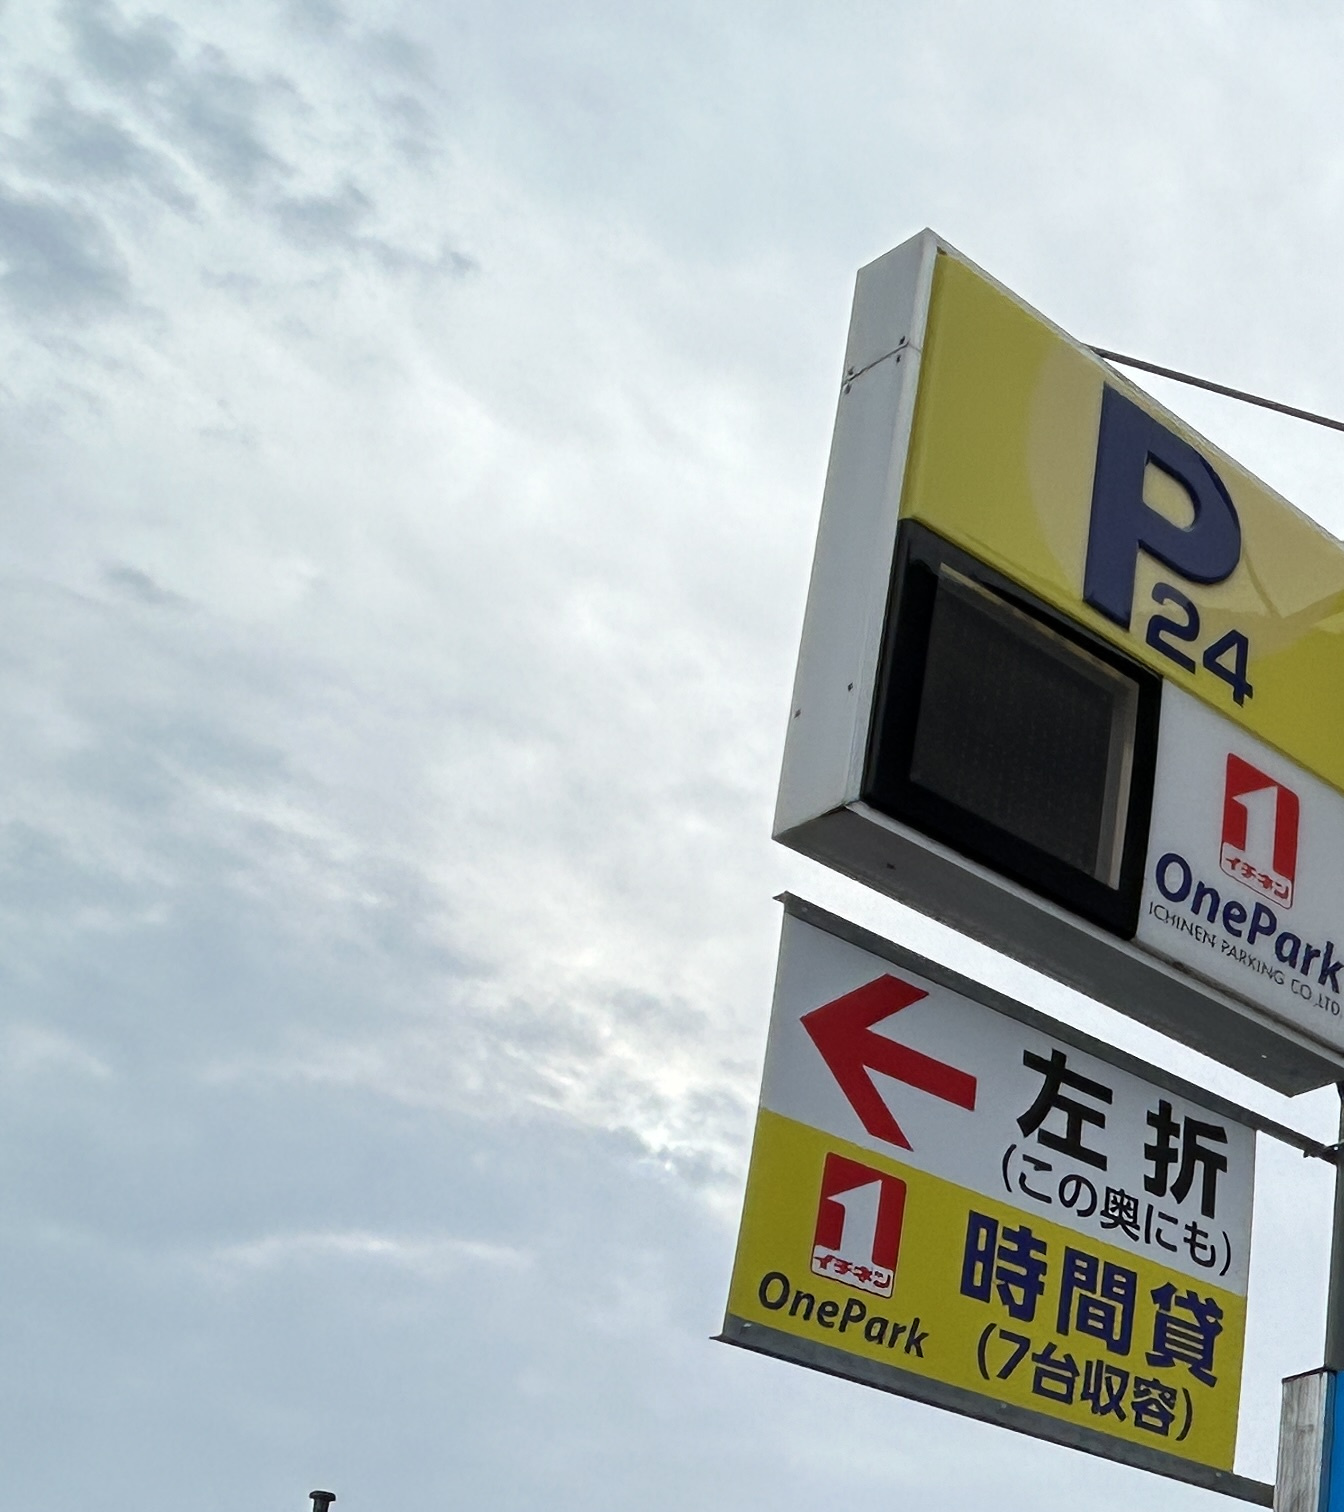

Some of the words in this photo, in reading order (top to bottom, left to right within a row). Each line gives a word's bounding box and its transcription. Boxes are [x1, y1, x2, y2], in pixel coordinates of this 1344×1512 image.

[1082, 381, 1241, 631] P
[1146, 582, 1254, 706] 24
[1149, 901, 1217, 948] ICHINEN
[1221, 938, 1285, 985] PARKING
[1155, 852, 1344, 994] OnePark
[1017, 1048, 1228, 1220] 左折
[814, 1252, 892, 1290] イチネン
[1001, 1143, 1232, 1276] (この奥にも)
[758, 1270, 931, 1358] OnePark
[960, 1209, 1224, 1388] 時間貸
[977, 1323, 1193, 1442] (7台収容)
